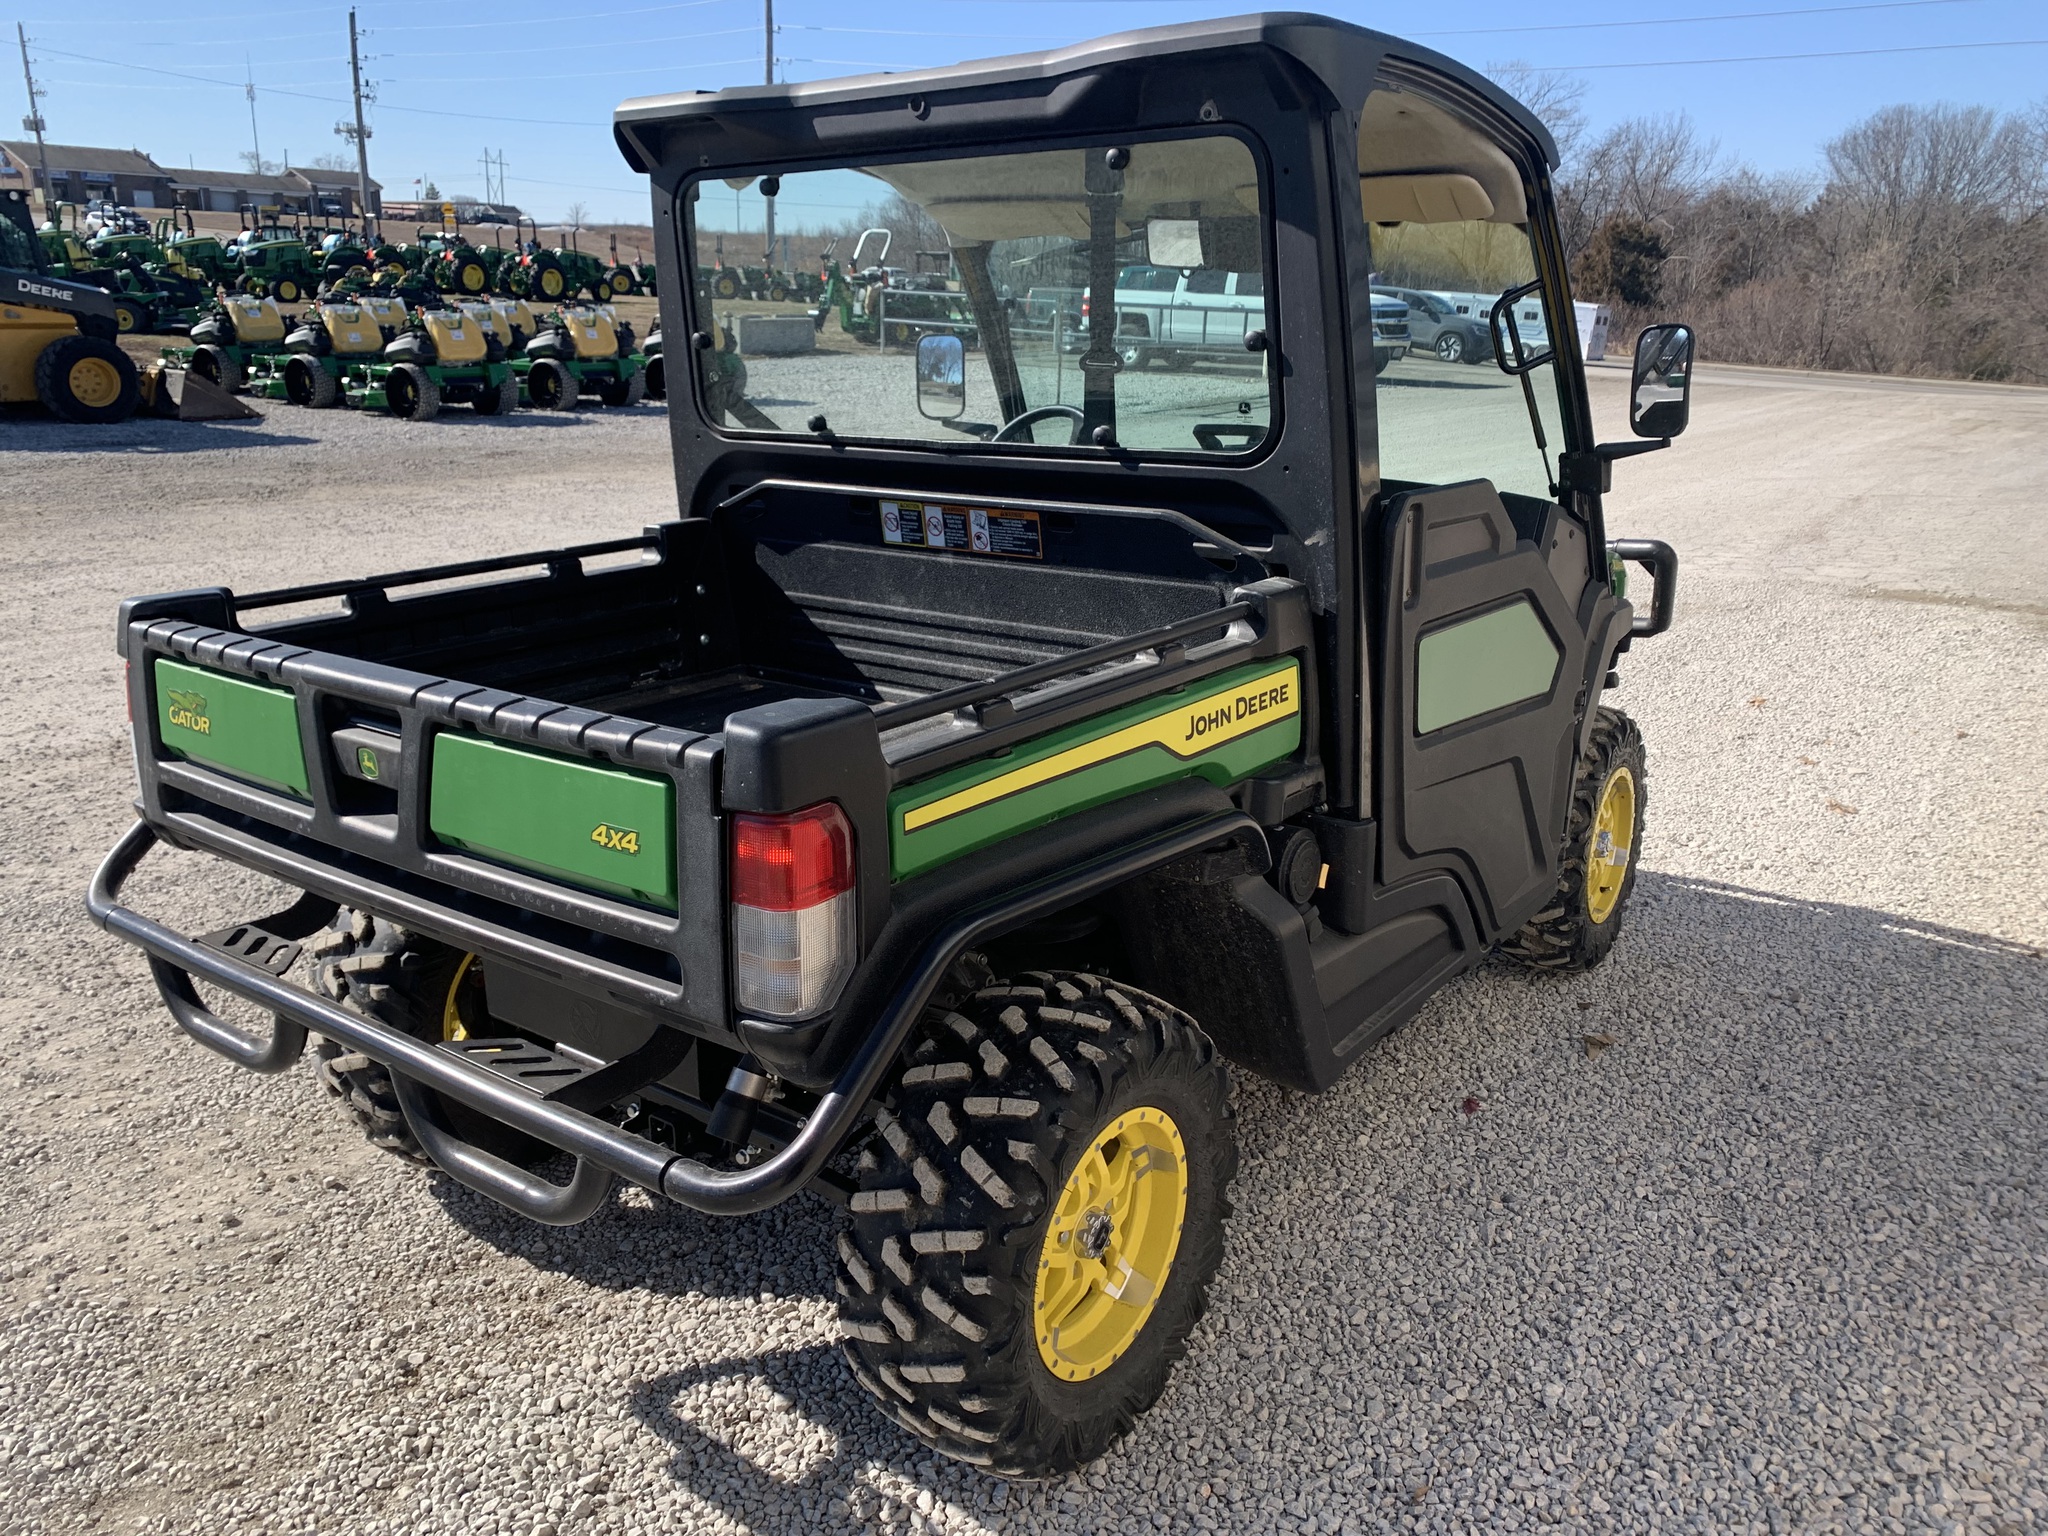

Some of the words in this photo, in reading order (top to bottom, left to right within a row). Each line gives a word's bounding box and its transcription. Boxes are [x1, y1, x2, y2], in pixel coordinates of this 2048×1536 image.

[17, 279, 73, 301] DEERE
[168, 705, 210, 735] GATOR
[1185, 705, 1231, 741] JOHN
[1236, 683, 1289, 721] DEERE
